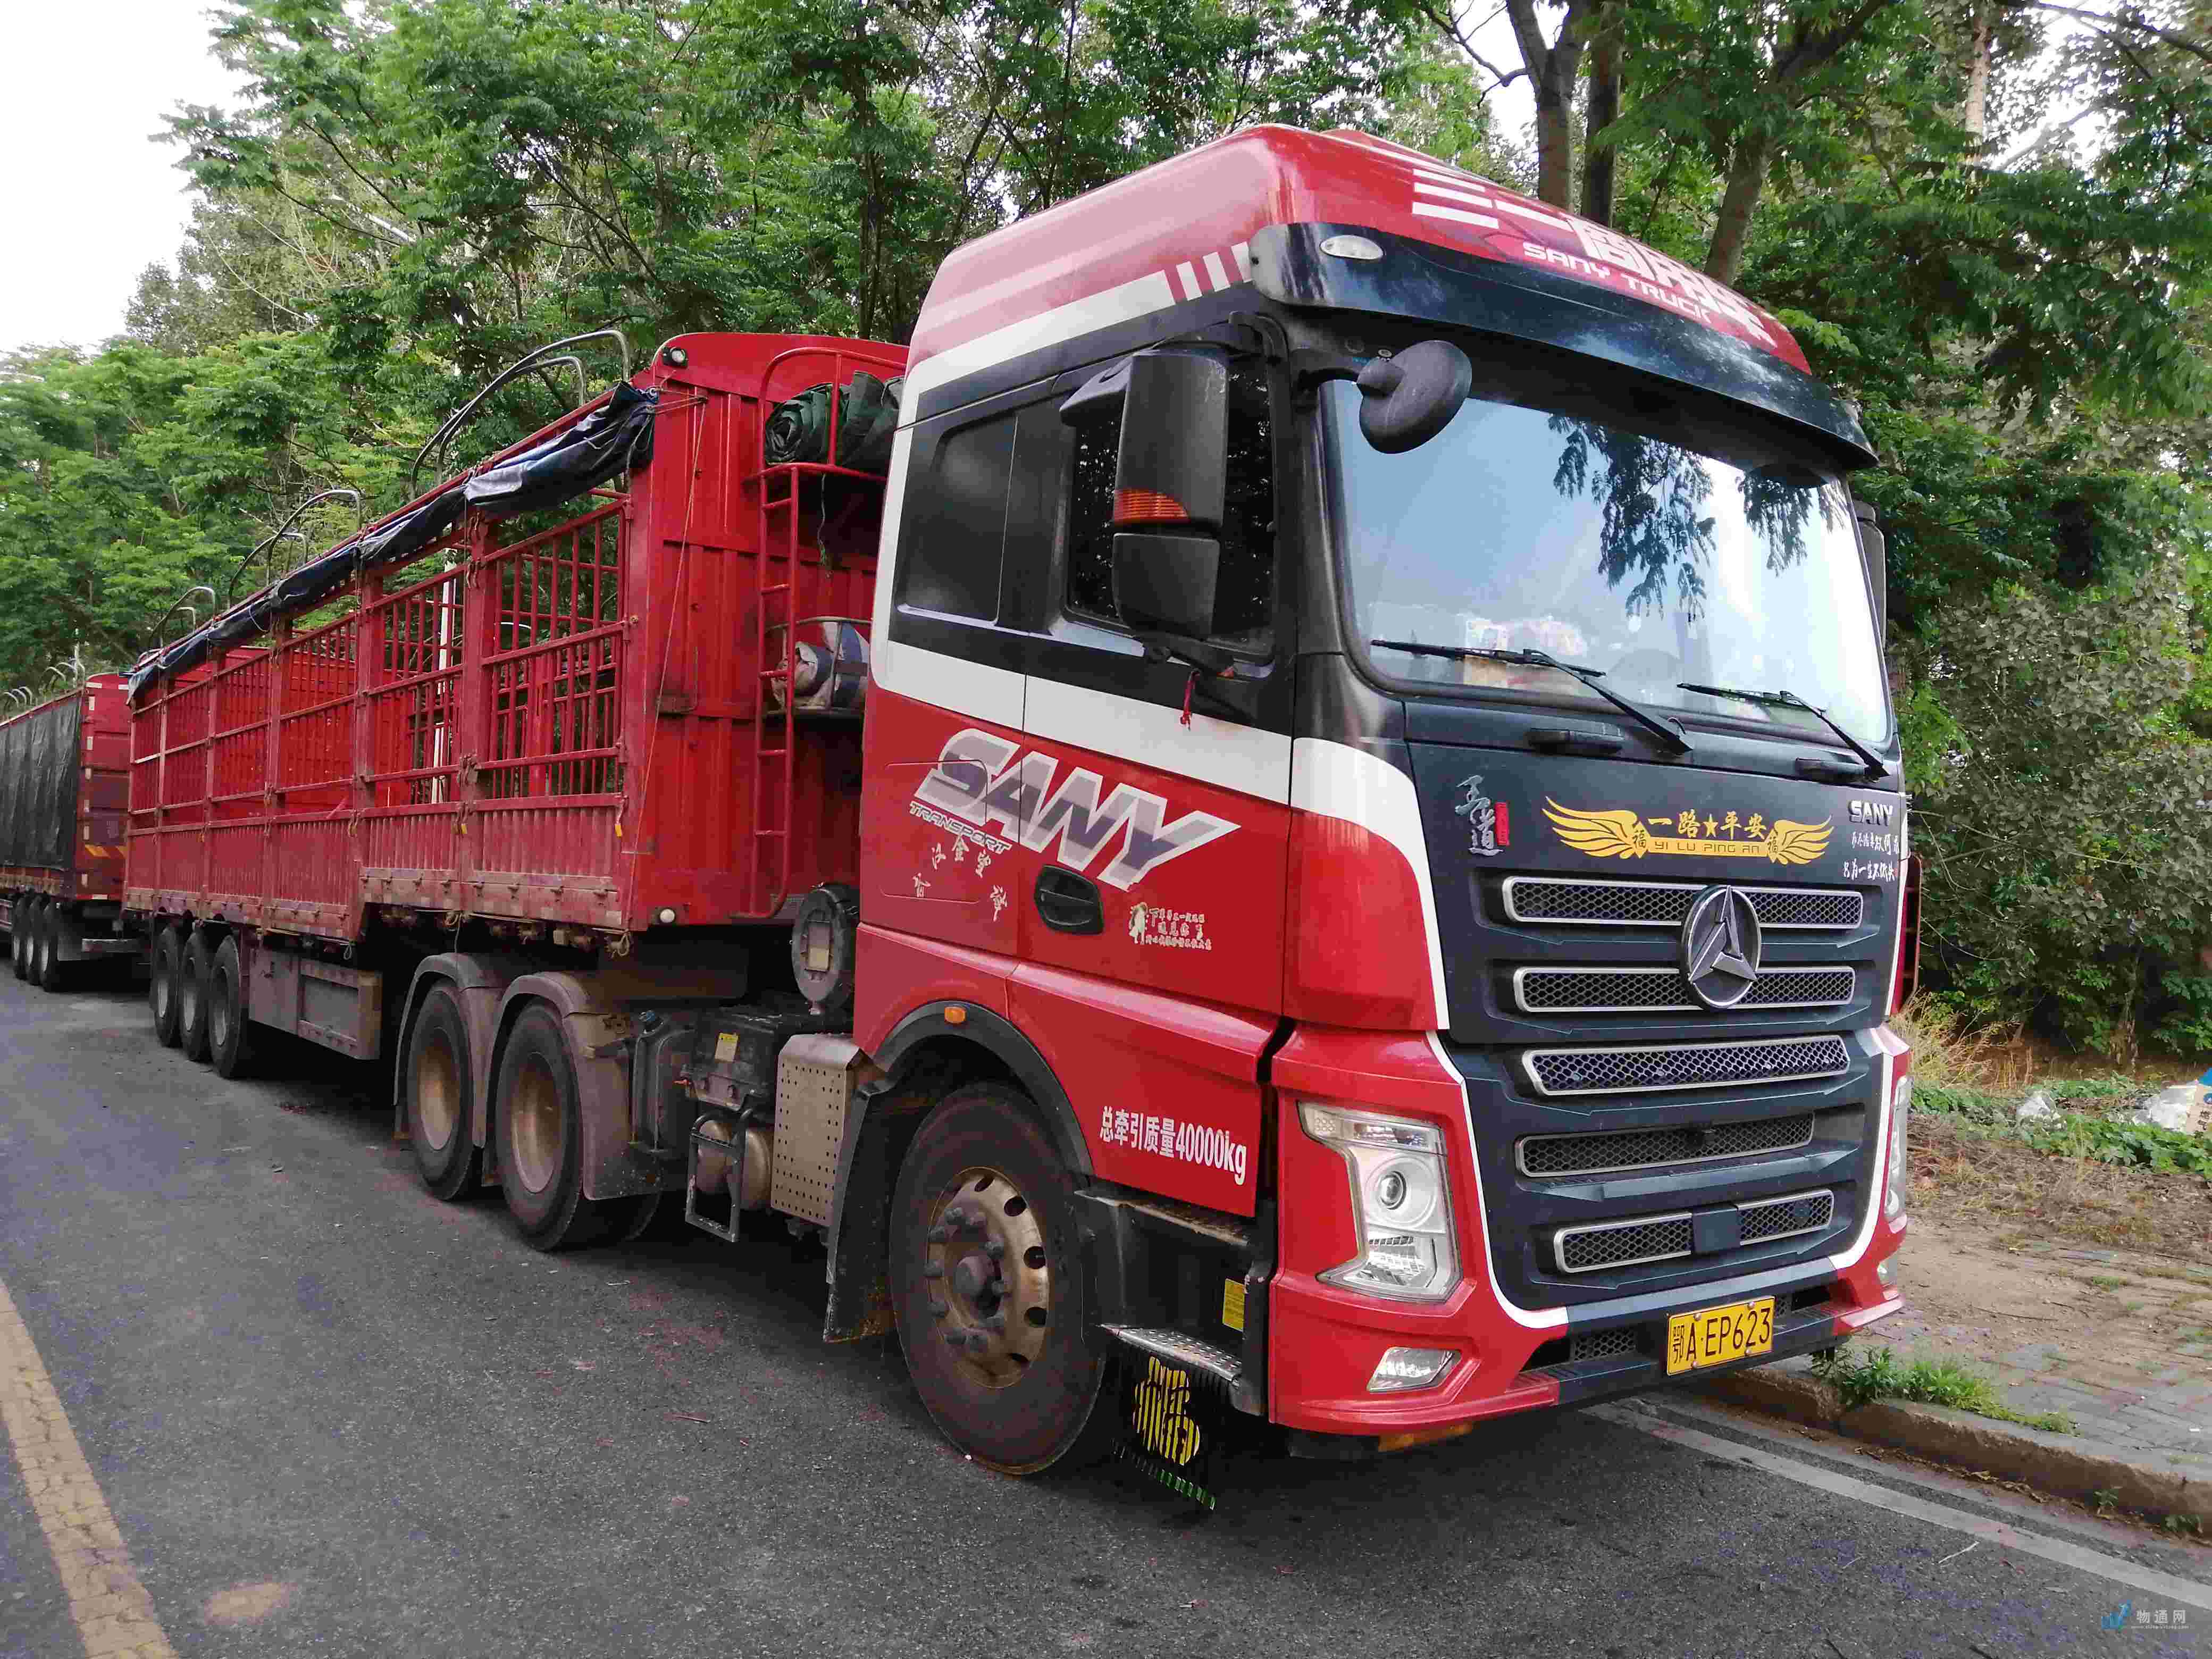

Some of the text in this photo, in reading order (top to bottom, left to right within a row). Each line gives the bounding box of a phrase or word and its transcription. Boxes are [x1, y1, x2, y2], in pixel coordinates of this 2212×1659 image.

[1522, 242, 1712, 324] SANY TRUCK
[909, 800, 1013, 854] TRANSPORT
[914, 728, 1242, 893] SANY
[1848, 800, 1893, 826] SANY
[1655, 841, 1759, 853] YI LU PING AN
[1100, 1105, 1246, 1185] 总牵引质量40000kg
